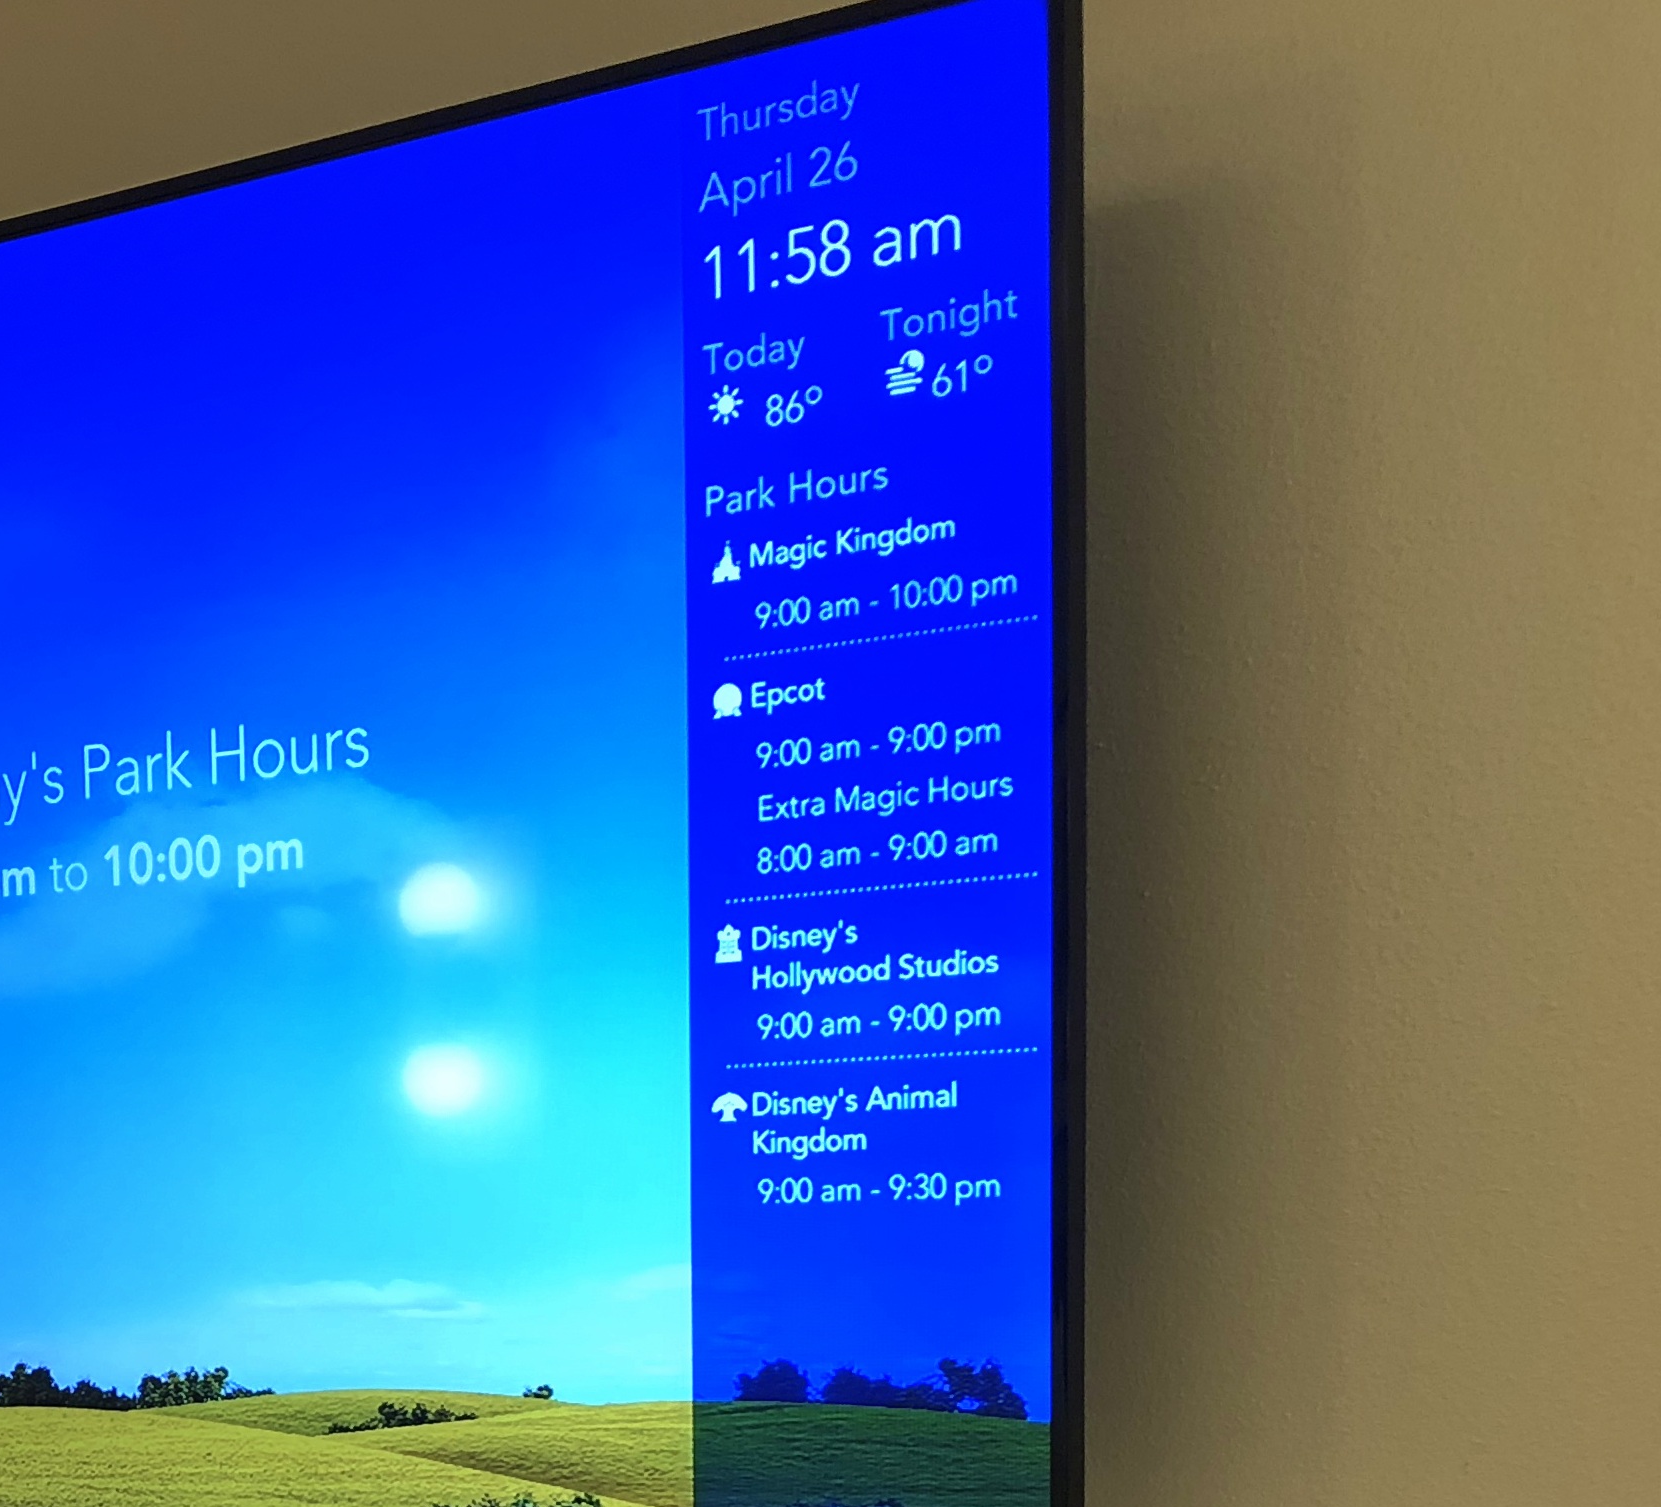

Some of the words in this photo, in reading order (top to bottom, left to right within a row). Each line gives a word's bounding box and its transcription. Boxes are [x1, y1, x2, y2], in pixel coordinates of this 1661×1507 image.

[697, 80, 860, 141] Thursday
[699, 153, 792, 216] April
[809, 141, 858, 188] 26
[704, 219, 851, 299] 11:58
[872, 214, 961, 267] am
[879, 289, 1018, 340] Tonight
[702, 333, 805, 374] Today
[706, 476, 775, 517] Park
[789, 467, 889, 503] Hours
[749, 530, 827, 570] Magic
[835, 517, 956, 556] Kingdom
[755, 596, 811, 629] 9:00
[819, 596, 859, 621] am
[889, 574, 963, 610] 10:00
[971, 573, 1017, 606] pm
[751, 678, 825, 715] Epcot
[83, 731, 191, 799] Park
[211, 725, 371, 784] Hours
[756, 738, 812, 769] 9:00
[820, 738, 860, 762] am
[888, 721, 947, 754] 9:00
[955, 722, 1001, 754] pm
[758, 794, 825, 822] Extra
[834, 781, 920, 816] Magic
[928, 775, 1014, 804] Hours
[49, 857, 88, 893] to
[104, 835, 220, 887] 10:00
[238, 838, 303, 888] pm
[756, 843, 812, 874] 8:00
[820, 844, 860, 868] am
[888, 830, 947, 861] 9:00
[955, 832, 998, 856] am
[751, 919, 858, 953] Disney's
[752, 955, 890, 994] Hollywood
[898, 949, 999, 980] Studios
[757, 1011, 813, 1040] 9:00
[820, 1014, 861, 1037] am
[888, 1002, 947, 1032] 9:00
[955, 1005, 1001, 1035] pm
[751, 1087, 858, 1120] Disney's
[866, 1081, 957, 1111] Animal
[752, 1126, 867, 1160] Kingdom
[757, 1177, 813, 1204] 9:00
[820, 1181, 861, 1202] am
[888, 1172, 947, 1200] 9:30
[955, 1177, 1001, 1206] pm
